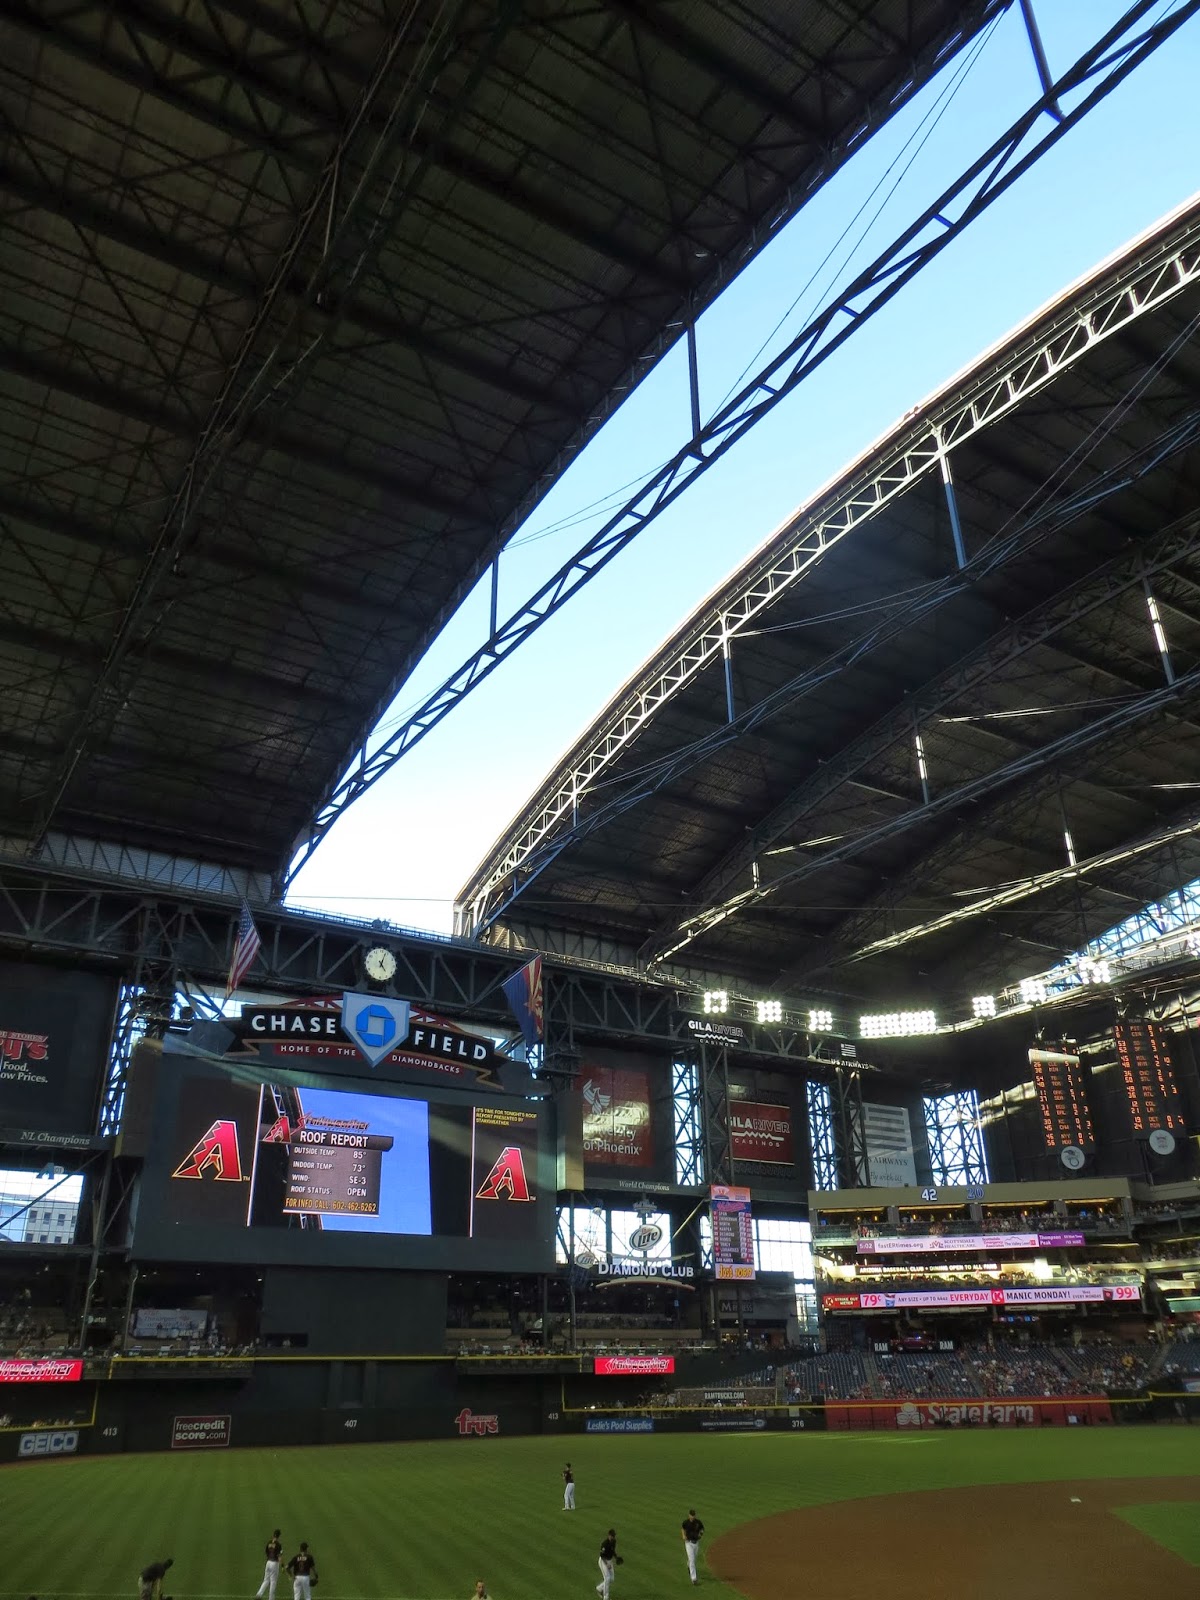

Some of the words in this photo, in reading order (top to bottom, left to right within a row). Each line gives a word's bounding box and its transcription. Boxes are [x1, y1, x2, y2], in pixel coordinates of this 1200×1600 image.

[688, 1020, 712, 1032] GILA
[712, 1024, 743, 1037] RIVER
[252, 1015, 336, 1034] CHASE
[414, 1030, 487, 1060] FIELD
[0, 1039, 48, 1060] y's
[3, 1061, 29, 1072] Food.
[392, 1055, 460, 1074] DIAMONDBACKS
[18, 1072, 48, 1083] Prices.
[753, 1119, 790, 1133] RIVER
[20, 1132, 36, 1140] NL
[37, 1132, 90, 1145] Champions
[300, 1130, 327, 1143] ROOF
[330, 1133, 369, 1147] REPORT
[735, 1138, 780, 1147] CASINOS
[294, 1147, 317, 1155] OUTSIDE
[353, 1151, 366, 1159] 85°
[583, 1140, 595, 1150] of
[598, 1140, 640, 1155] Phoenix
[316, 1162, 334, 1171] TEMP:
[352, 1164, 366, 1172] 73°
[873, 1157, 908, 1166] AIRWAYS
[349, 1176, 366, 1184] SE-3
[347, 1188, 367, 1197] OPEN
[638, 1183, 670, 1191] Champions
[922, 1189, 937, 1201] 42
[967, 1187, 984, 1199] 20
[286, 1198, 296, 1207] FOR
[298, 1199, 312, 1208] INFO
[314, 1200, 331, 1209] CALL:
[638, 1231, 658, 1248] Lite
[598, 1262, 657, 1276] DIAMOND
[662, 1265, 694, 1277] CLUB
[950, 1293, 989, 1302] EVERYDAY
[1006, 1291, 1032, 1300] MANIC
[1034, 1290, 1070, 1299] MONDAY!
[874, 1343, 888, 1351] RAM
[939, 1341, 954, 1350] RAM
[928, 1402, 980, 1424] State
[982, 1402, 1034, 1422] Farm
[176, 1420, 225, 1430] freecredit
[588, 1422, 610, 1430] Leslie's
[611, 1422, 625, 1430] Pool
[626, 1421, 652, 1431] Supplies
[103, 1428, 118, 1436] 413
[175, 1432, 226, 1440] score.com
[20, 1433, 78, 1453] GEICO
